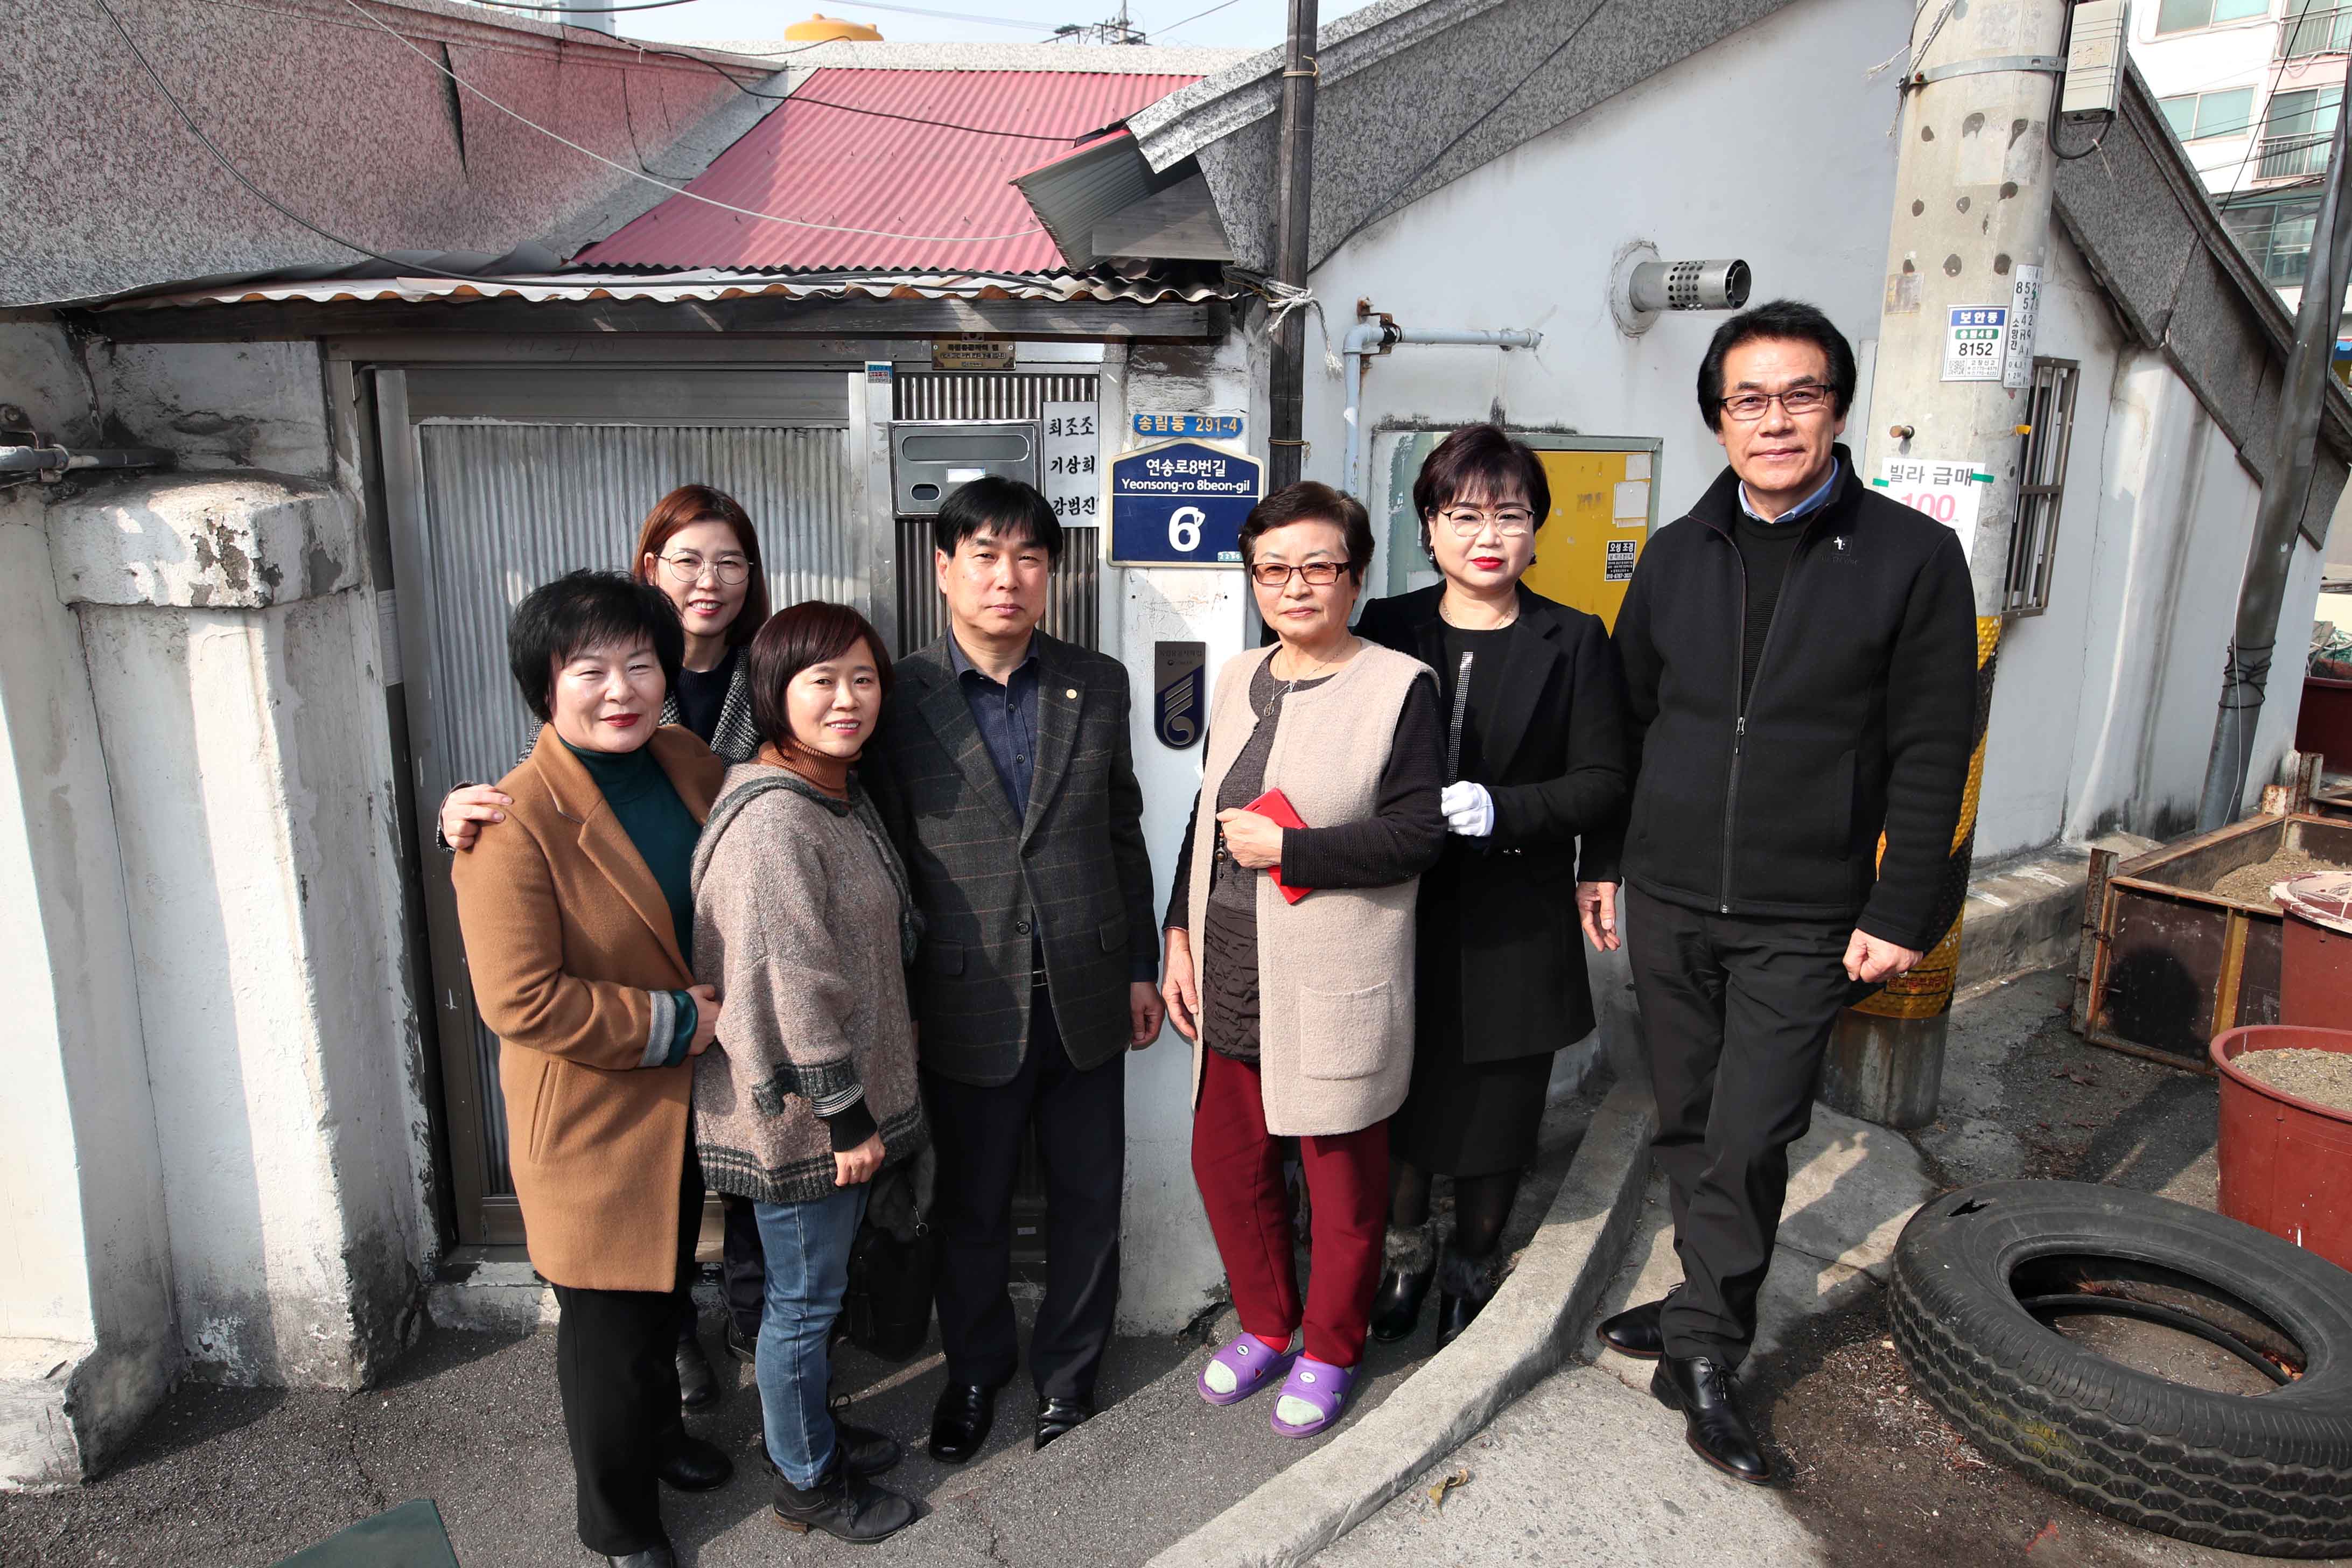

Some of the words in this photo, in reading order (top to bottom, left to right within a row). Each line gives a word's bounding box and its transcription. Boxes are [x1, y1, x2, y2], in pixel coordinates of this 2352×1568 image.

[1960, 311, 1997, 324] 보안등
[1959, 342, 1993, 356] 8152
[1138, 415, 1185, 432] 송림동
[1195, 418, 1237, 432] 291-4
[1050, 455, 1095, 474] 기상희
[1146, 459, 1226, 477] 연송로8번길
[1891, 465, 1925, 484] 빌라
[1933, 467, 1974, 487] 급매
[1122, 479, 1194, 493] Yeonsong-ro
[1197, 479, 1250, 494] 8beon-gil
[1053, 496, 1096, 516] 강범진
[1168, 506, 1204, 552] 6
[1609, 543, 1621, 552] 오성
[1622, 542, 1634, 552] 조경
